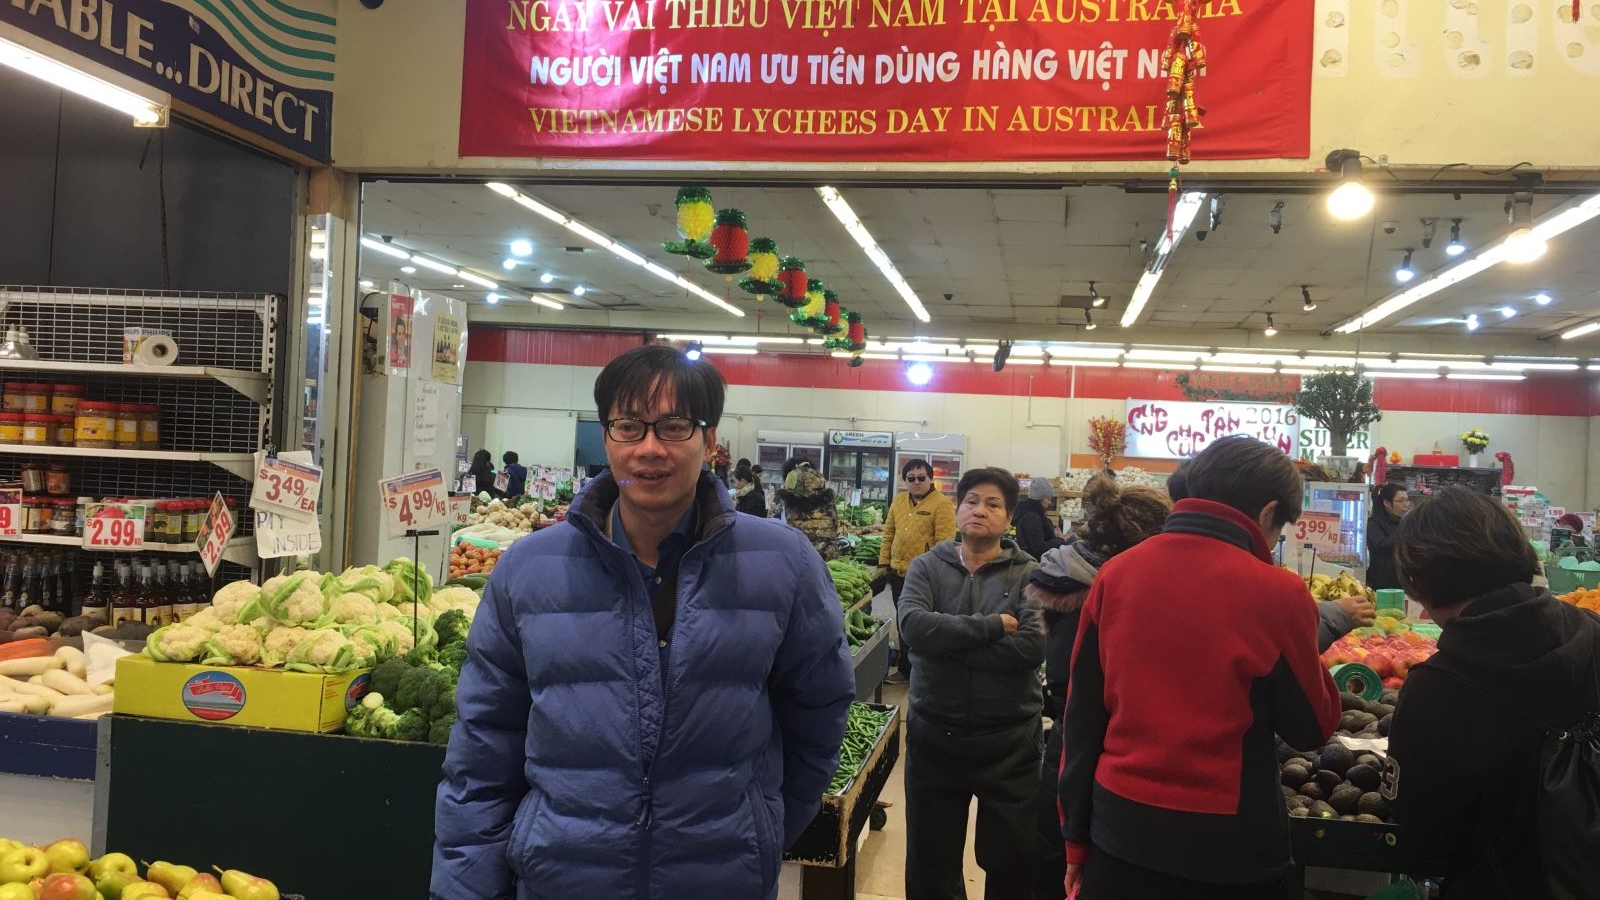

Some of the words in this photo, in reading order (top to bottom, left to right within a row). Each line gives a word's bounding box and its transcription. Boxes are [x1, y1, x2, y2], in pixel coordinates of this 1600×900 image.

[868, 0, 946, 28] NAM
[961, 0, 1019, 31] TẠI
[1028, 0, 1243, 24] AUSTRAIA
[11, 0, 184, 84] ABLE...
[188, 43, 320, 142] DIRECT
[530, 48, 621, 87] NGƯỜI
[630, 46, 682, 95] VIỆT
[691, 52, 751, 85] NAM
[760, 54, 799, 86] ƯU
[808, 46, 865, 86] TIÊN
[874, 45, 961, 85] DÙNG
[971, 41, 1058, 81] HÀNG
[1067, 41, 1129, 91] VIỆT
[528, 107, 723, 135] VIETNAMESE
[731, 109, 878, 135] LYCHEES
[885, 107, 953, 134] DAY
[962, 106, 1000, 132] IN
[1007, 106, 1205, 132] AUSTRAL
[1246, 406, 1297, 426] 2016
[1300, 429, 1369, 450] SUER
[273, 532, 320, 555] INSIDE
